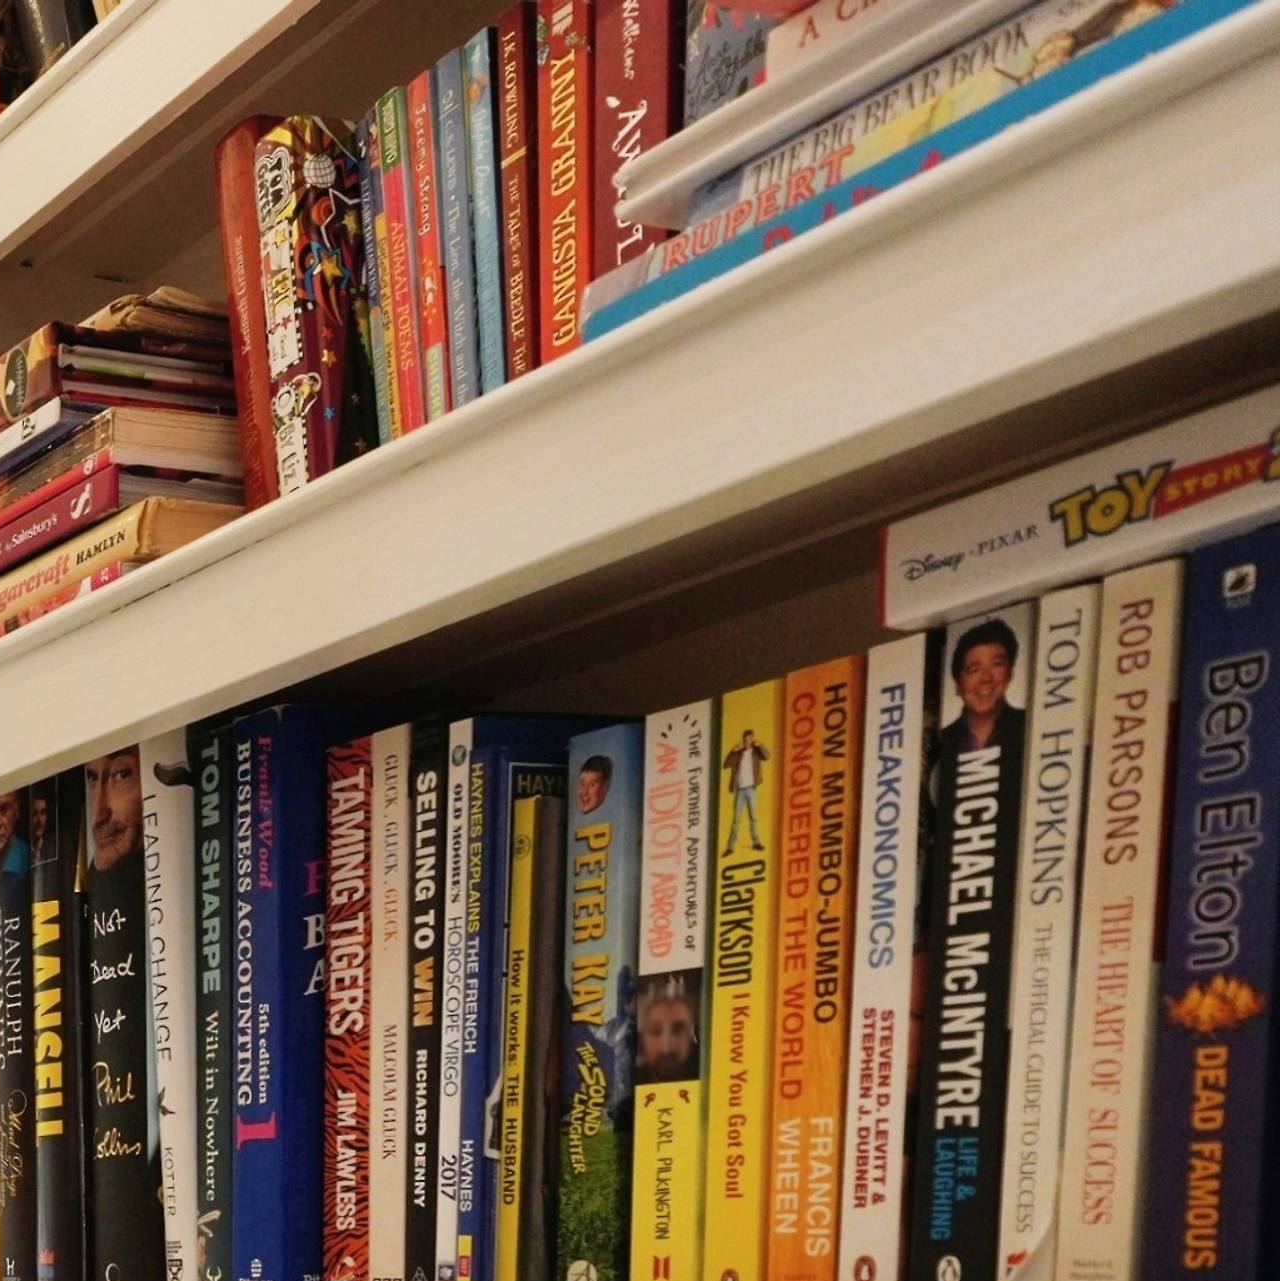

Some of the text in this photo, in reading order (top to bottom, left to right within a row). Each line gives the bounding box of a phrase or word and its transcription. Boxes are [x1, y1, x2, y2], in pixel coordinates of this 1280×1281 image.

[414, 102, 431, 236] Jeremy Strong
[751, 21, 1031, 194] THE BIG BEAR BOOK
[551, 49, 576, 347] GANGSTA GRANNY
[659, 145, 855, 273] RUPERT
[391, 222, 414, 371] ANIMAL POEMS
[452, 303, 464, 349] Witch
[510, 271, 525, 338] BEEDLE
[11, 513, 58, 546] Sainsbury's
[76, 529, 125, 565] HAMLYN
[977, 524, 1039, 555] PIXAR
[1050, 457, 1262, 549] TOY STORY
[1030, 608, 1082, 907] TOM HOPKINS
[1104, 598, 1154, 867] ROB PARSONS
[201, 737, 221, 994] TOM SHARPE
[647, 782, 684, 958] IDIOT ABROAD
[685, 837, 701, 929] ADVENTURES
[869, 683, 906, 969] FREAKONOMICS
[1191, 651, 1270, 970] Ben Elton
[91, 953, 135, 984] Dead
[236, 738, 252, 1106] BUSINESS ACCOUNTING
[328, 767, 366, 1036] TAMING TIGERS
[414, 770, 437, 1026] SELLING TO WIN
[571, 823, 612, 1026] PETER KAY
[718, 859, 766, 989] Clarkson
[780, 692, 817, 1101] CONQUERED THE WORLD
[813, 770, 846, 1025] MUMBO-JUMBO
[936, 745, 1002, 1130] MICHAEL McINTYRE
[1100, 896, 1133, 955] THE
[5, 916, 22, 1056] RANULPH
[440, 917, 463, 1201] HOROSCOPE VIRGO 2017
[459, 842, 483, 1212] EXPLAINS FRENCH HAYNES
[1093, 962, 1129, 1051] HEART
[92, 1061, 135, 1108] Phil
[206, 1097, 220, 1201] Nowhere
[414, 1049, 428, 1208] RICHARD DENNY
[724, 1005, 751, 1199] Know You Got Soul
[854, 1008, 877, 1209] STEPHEN DUBNER
[872, 1010, 895, 1180] STEVEN LEVITT
[1016, 1053, 1045, 1234] GUIDE SUCCESS
[1184, 1046, 1228, 1270] DEAD FAMOUS
[336, 1135, 359, 1231] LAWLESS
[503, 1117, 517, 1206] HUSBAND
[654, 1107, 674, 1241] KARL PILKINGTON
[775, 1118, 801, 1235] WHEEN
[805, 1115, 834, 1258] FRANCIS
[930, 1138, 956, 1240] LAUGHING
[1081, 1109, 1119, 1226] SUCCESS
